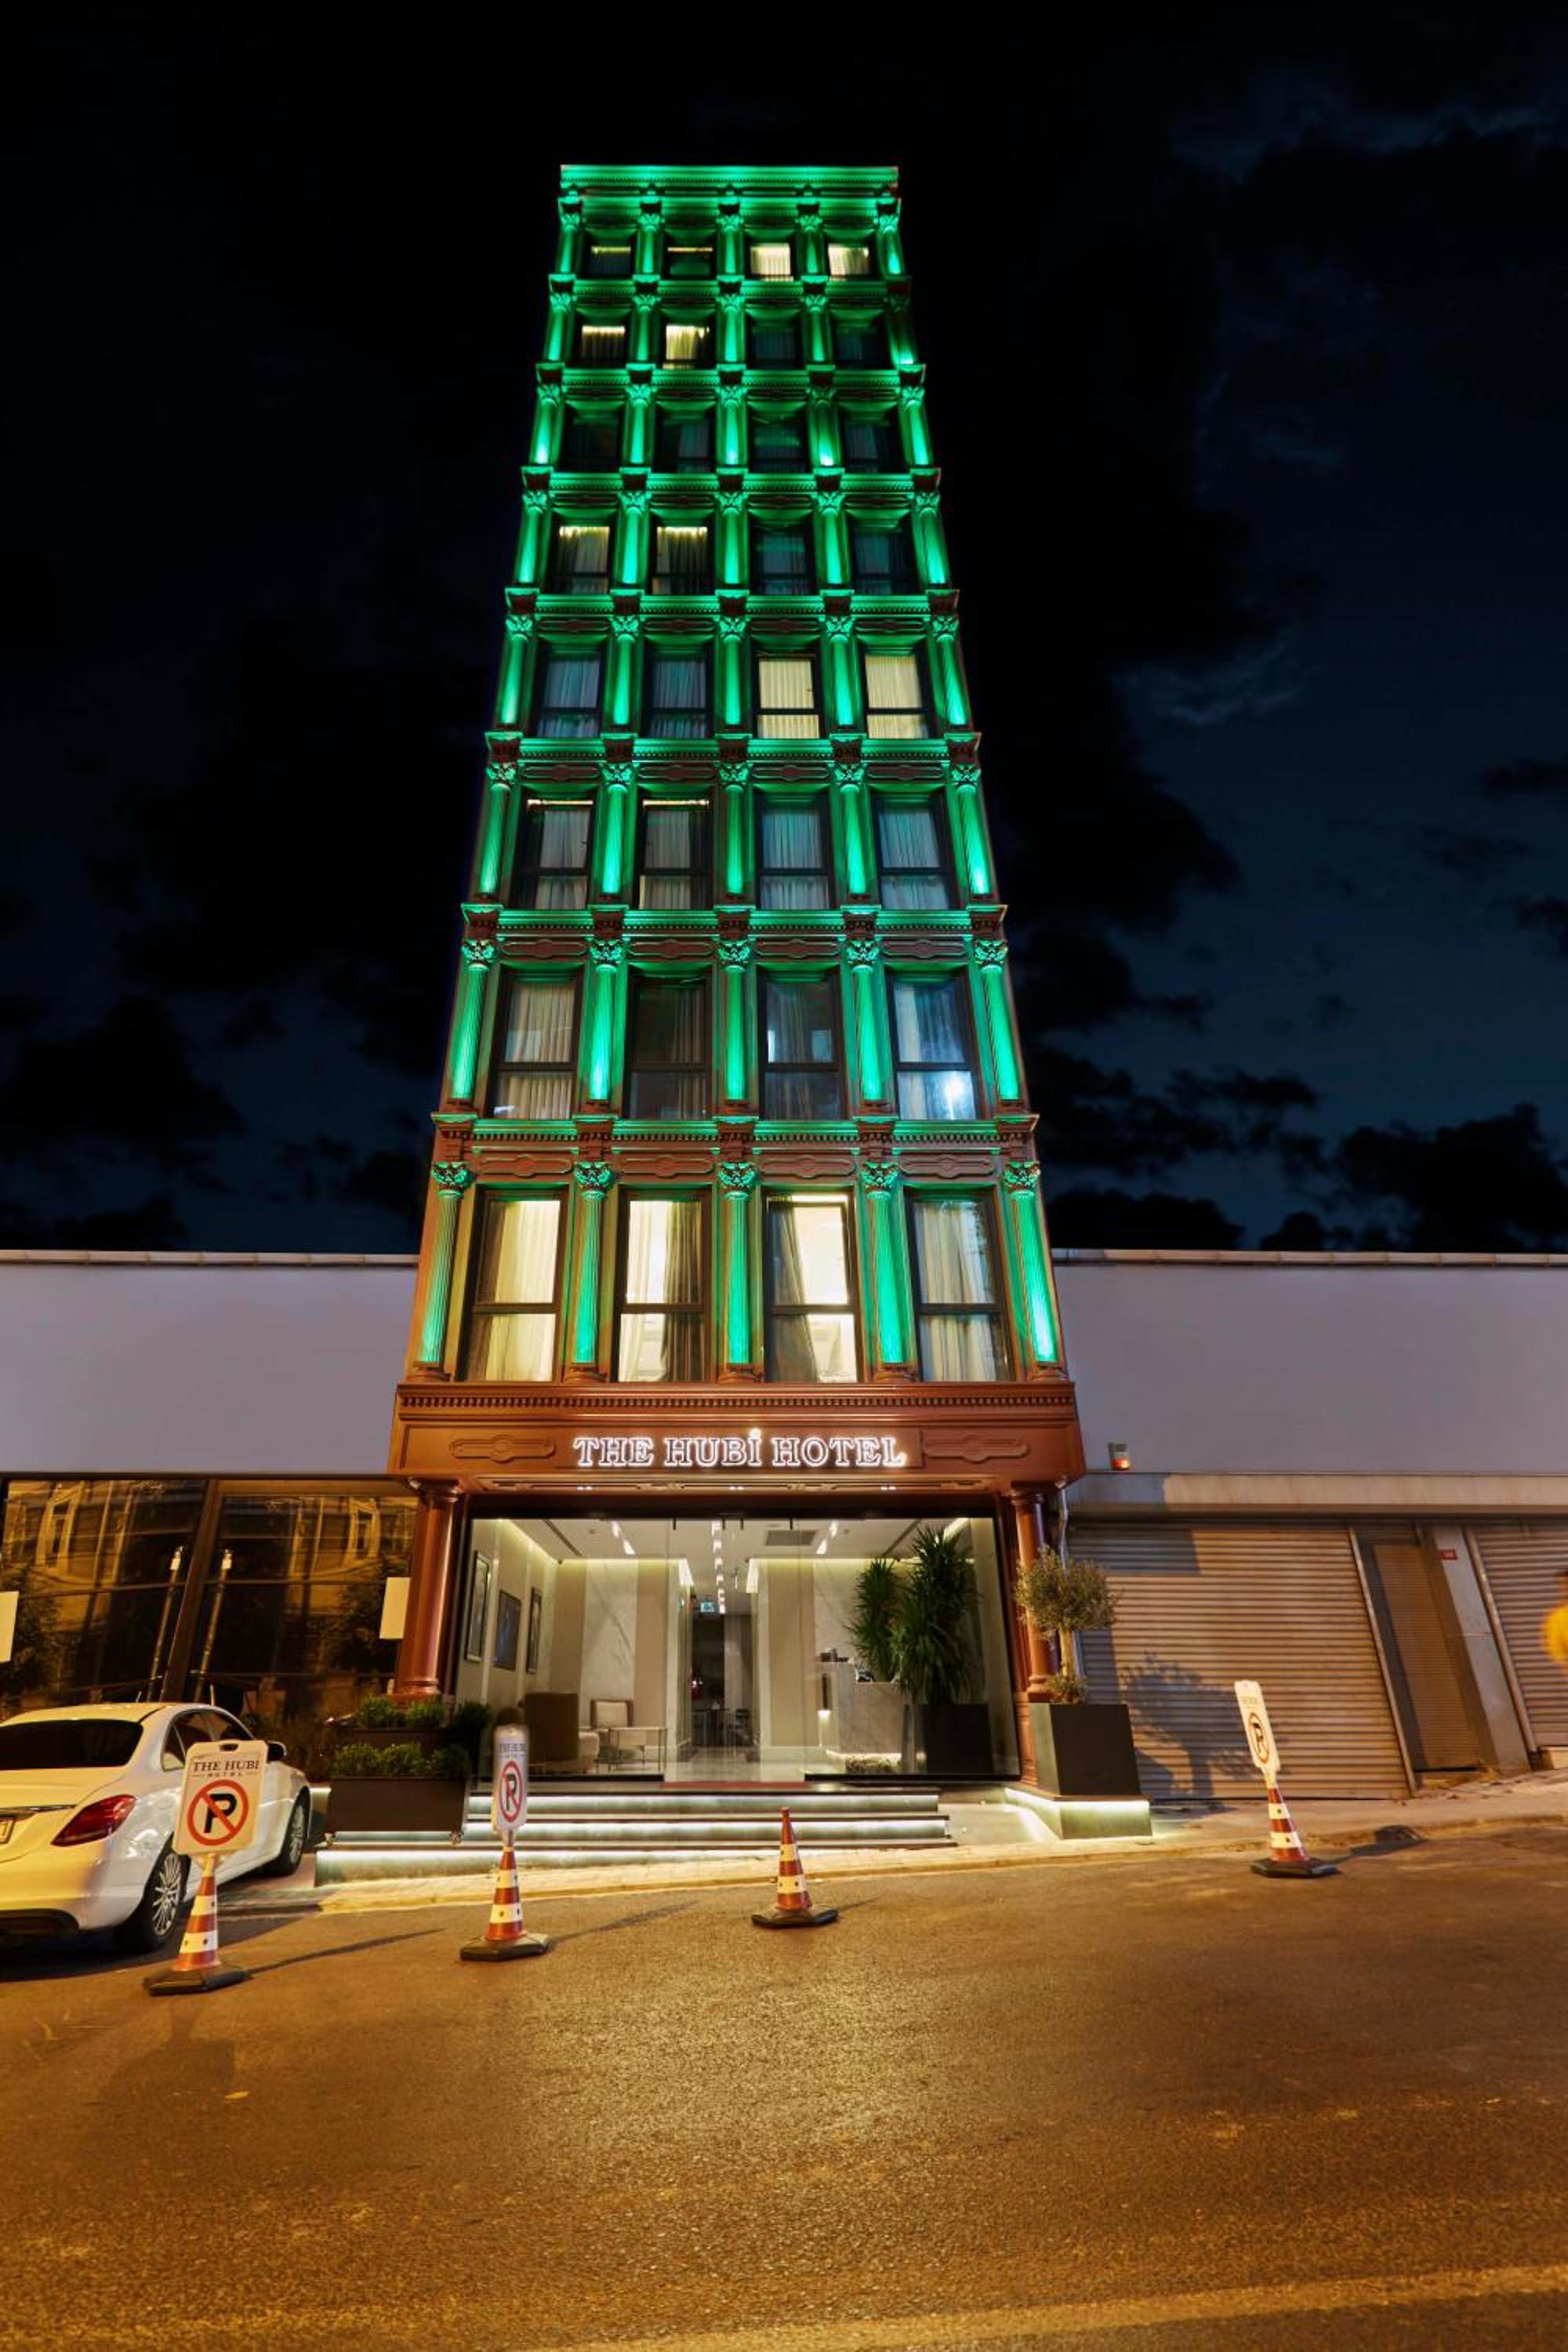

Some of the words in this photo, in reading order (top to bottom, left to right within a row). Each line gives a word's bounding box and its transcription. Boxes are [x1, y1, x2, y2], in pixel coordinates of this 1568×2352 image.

[572, 1436, 655, 1467] THE
[771, 1436, 908, 1467] HOTEL
[193, 1761, 222, 1772] THE
